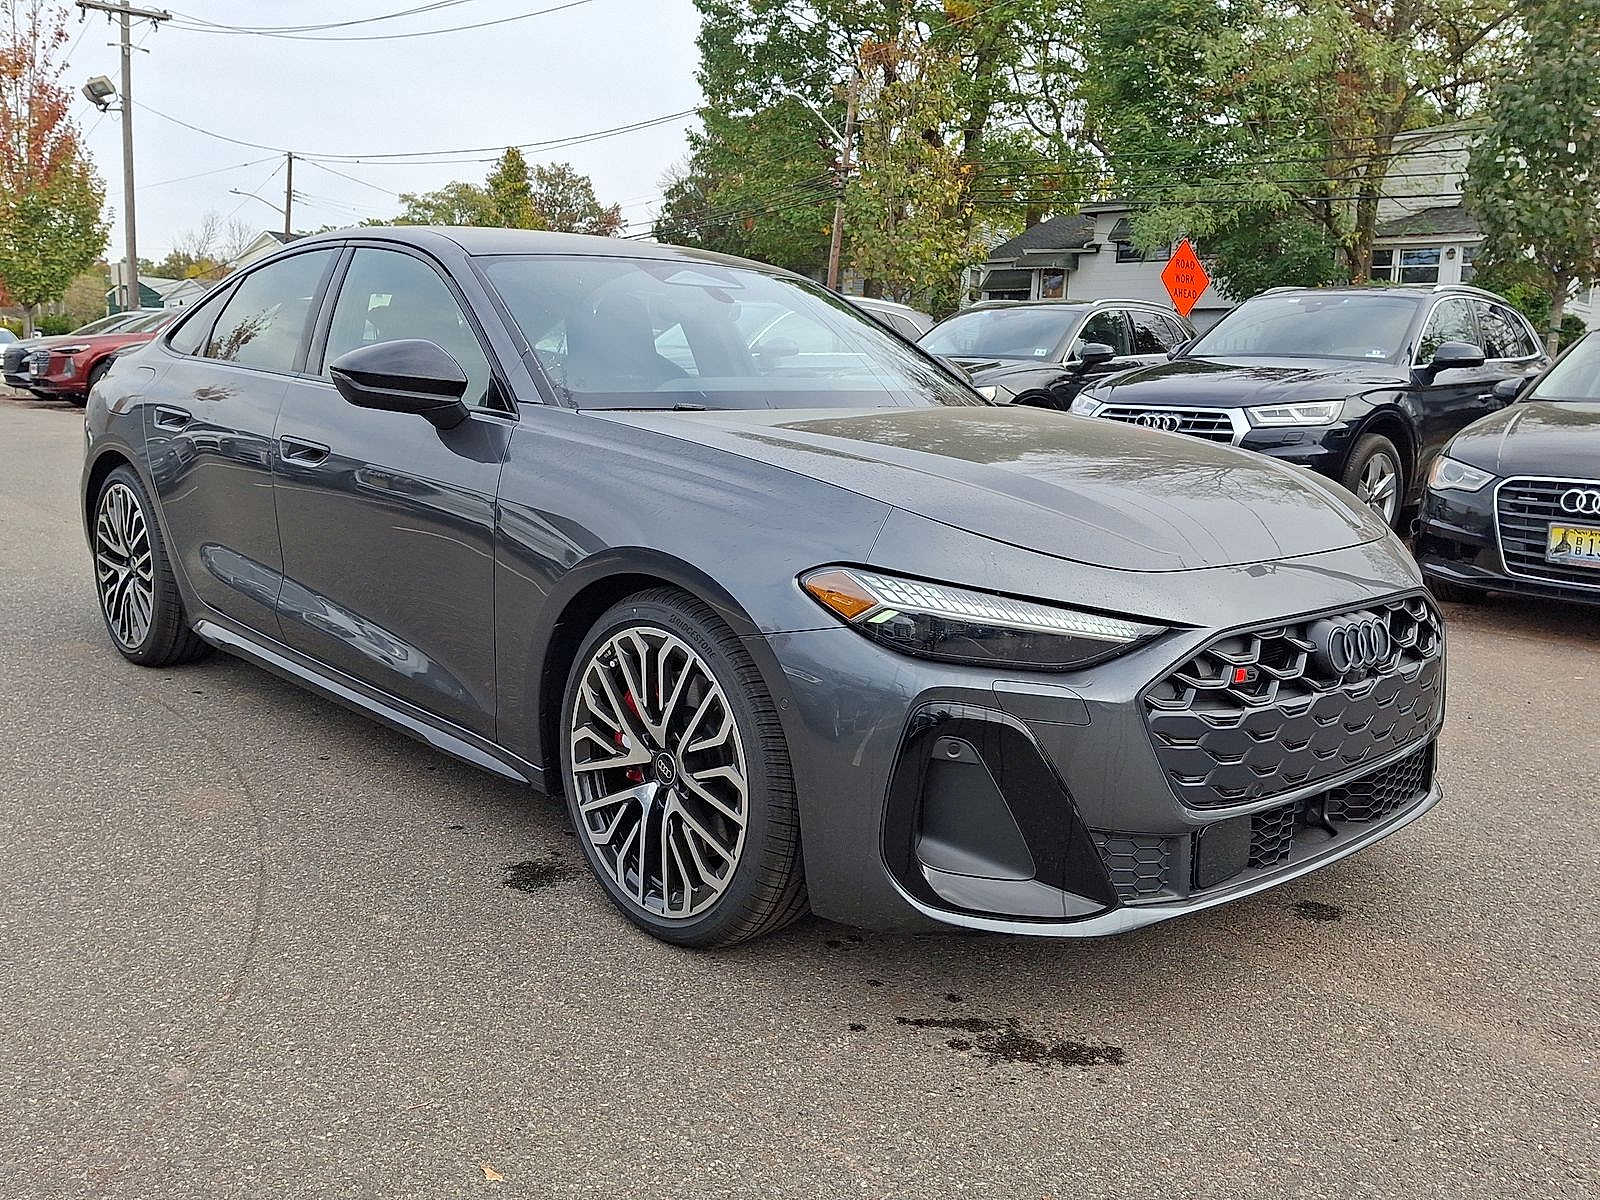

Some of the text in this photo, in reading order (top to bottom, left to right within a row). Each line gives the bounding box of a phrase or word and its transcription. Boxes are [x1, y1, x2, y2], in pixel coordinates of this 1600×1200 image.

[1175, 259, 1195, 270] ROAD
[1175, 274, 1195, 285] WORK
[1173, 287, 1197, 299] AHEAD
[668, 614, 716, 659] BRIDGESTONE
